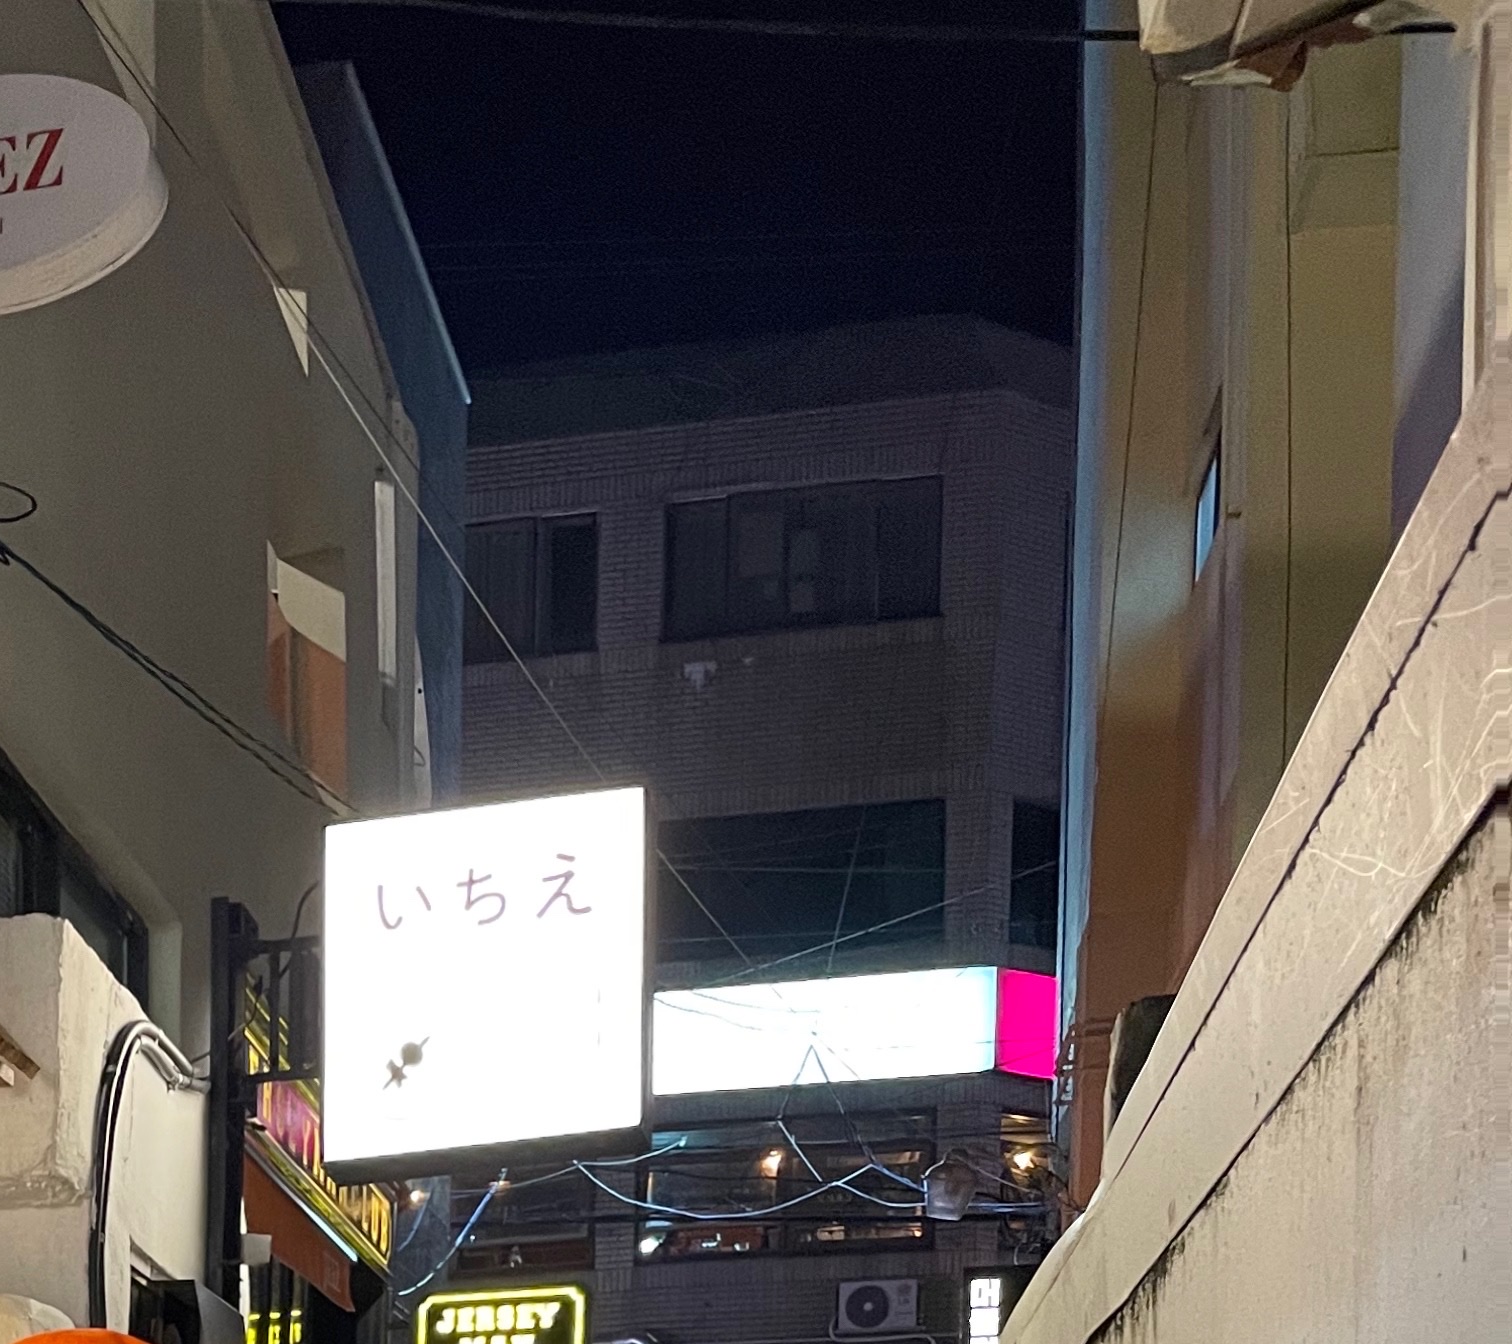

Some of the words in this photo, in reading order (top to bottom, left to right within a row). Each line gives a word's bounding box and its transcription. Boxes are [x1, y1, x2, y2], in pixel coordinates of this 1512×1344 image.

[376, 852, 593, 931] いちえ
[436, 1302, 561, 1334] JERSEY
